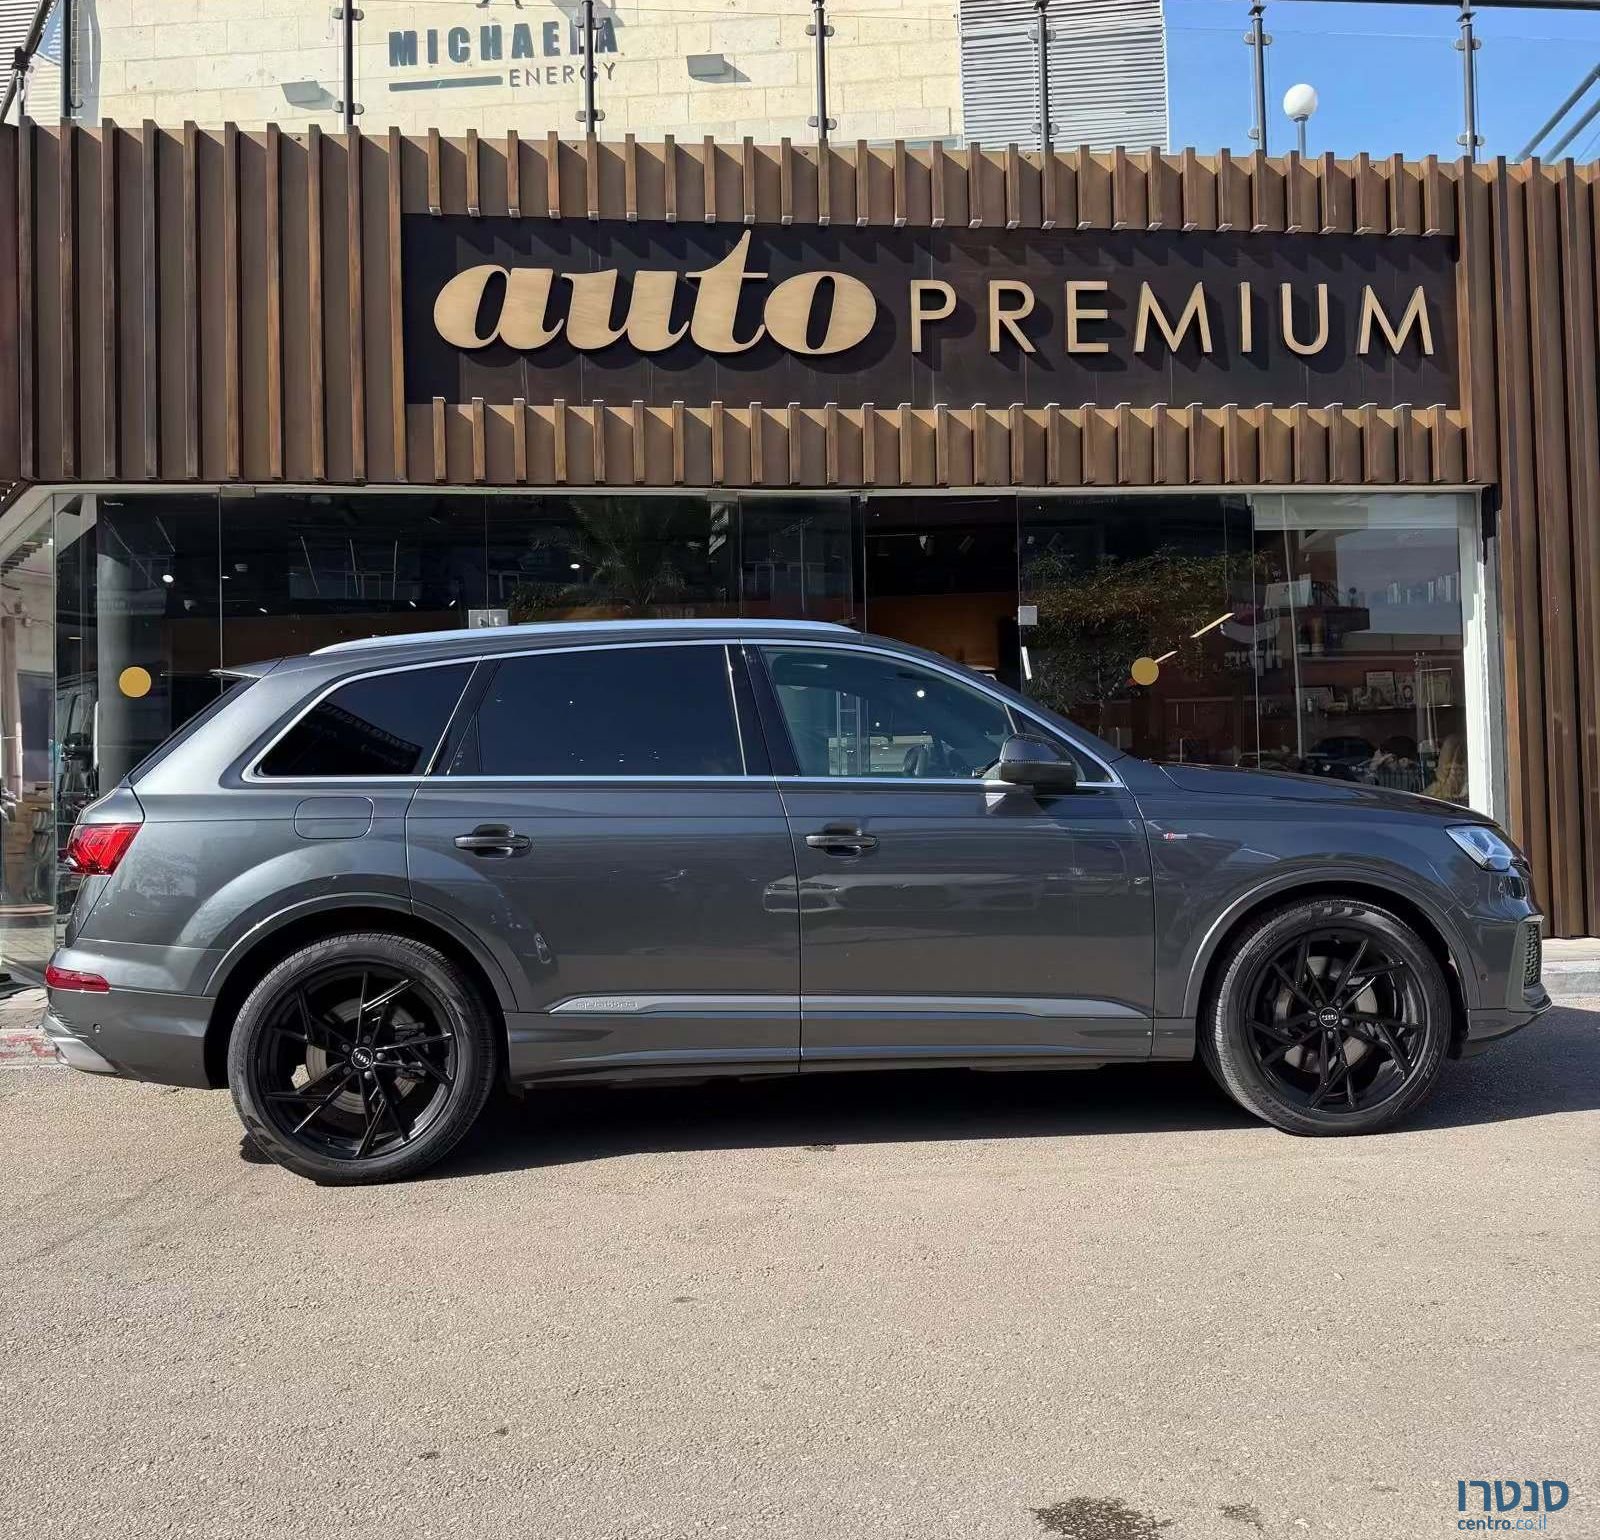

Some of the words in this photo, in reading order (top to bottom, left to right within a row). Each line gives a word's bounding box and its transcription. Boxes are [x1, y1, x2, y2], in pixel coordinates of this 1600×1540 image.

[509, 62, 616, 88] ENERGY
[433, 229, 877, 354] auto
[910, 280, 1434, 355] PREMIUM
